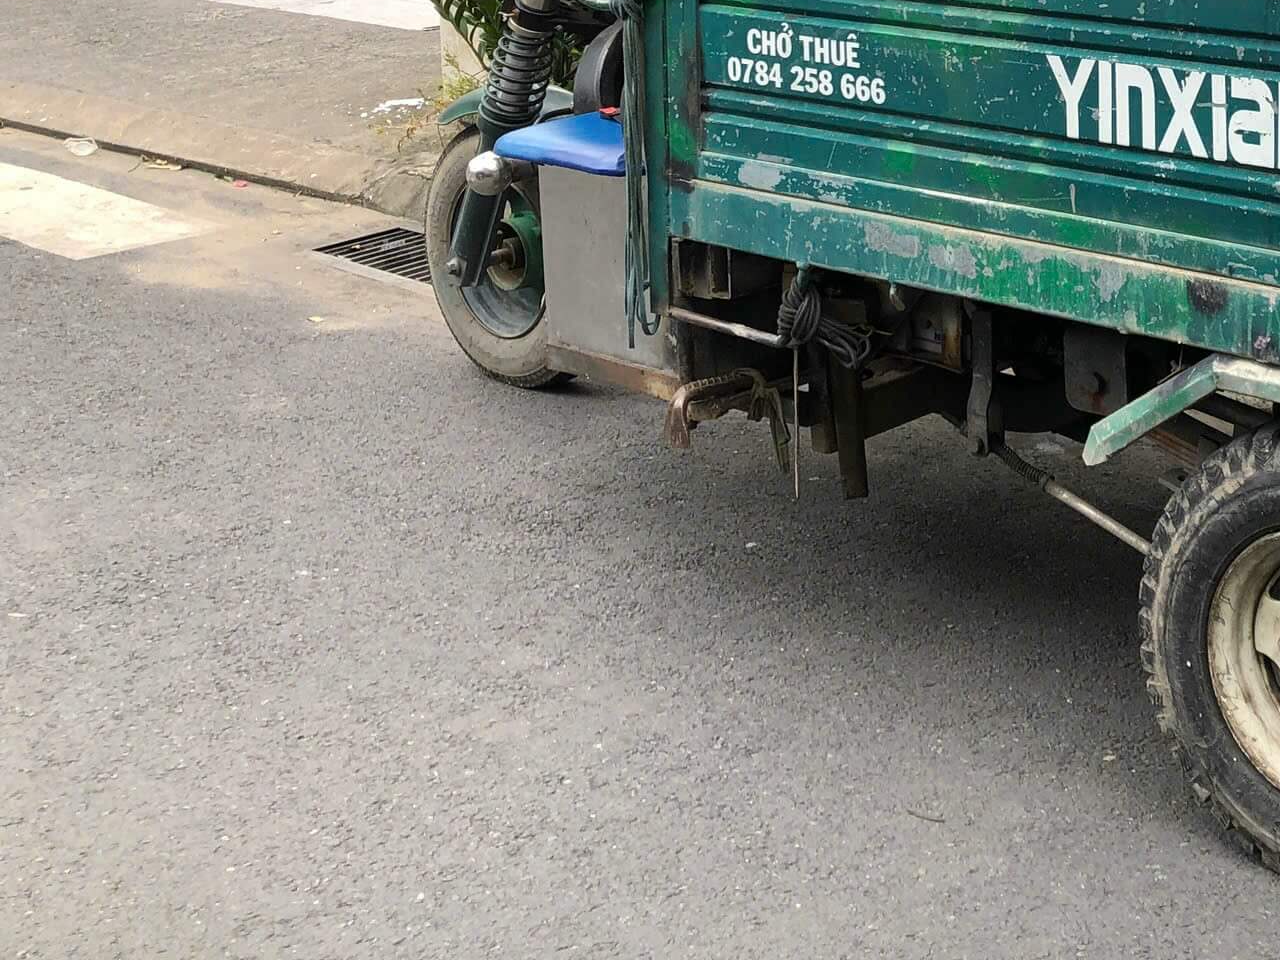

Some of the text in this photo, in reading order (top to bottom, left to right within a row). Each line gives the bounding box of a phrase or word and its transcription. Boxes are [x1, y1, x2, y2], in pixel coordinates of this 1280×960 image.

[746, 22, 861, 69] CHỞ THUÊ
[727, 56, 886, 105] 0784 258 666
